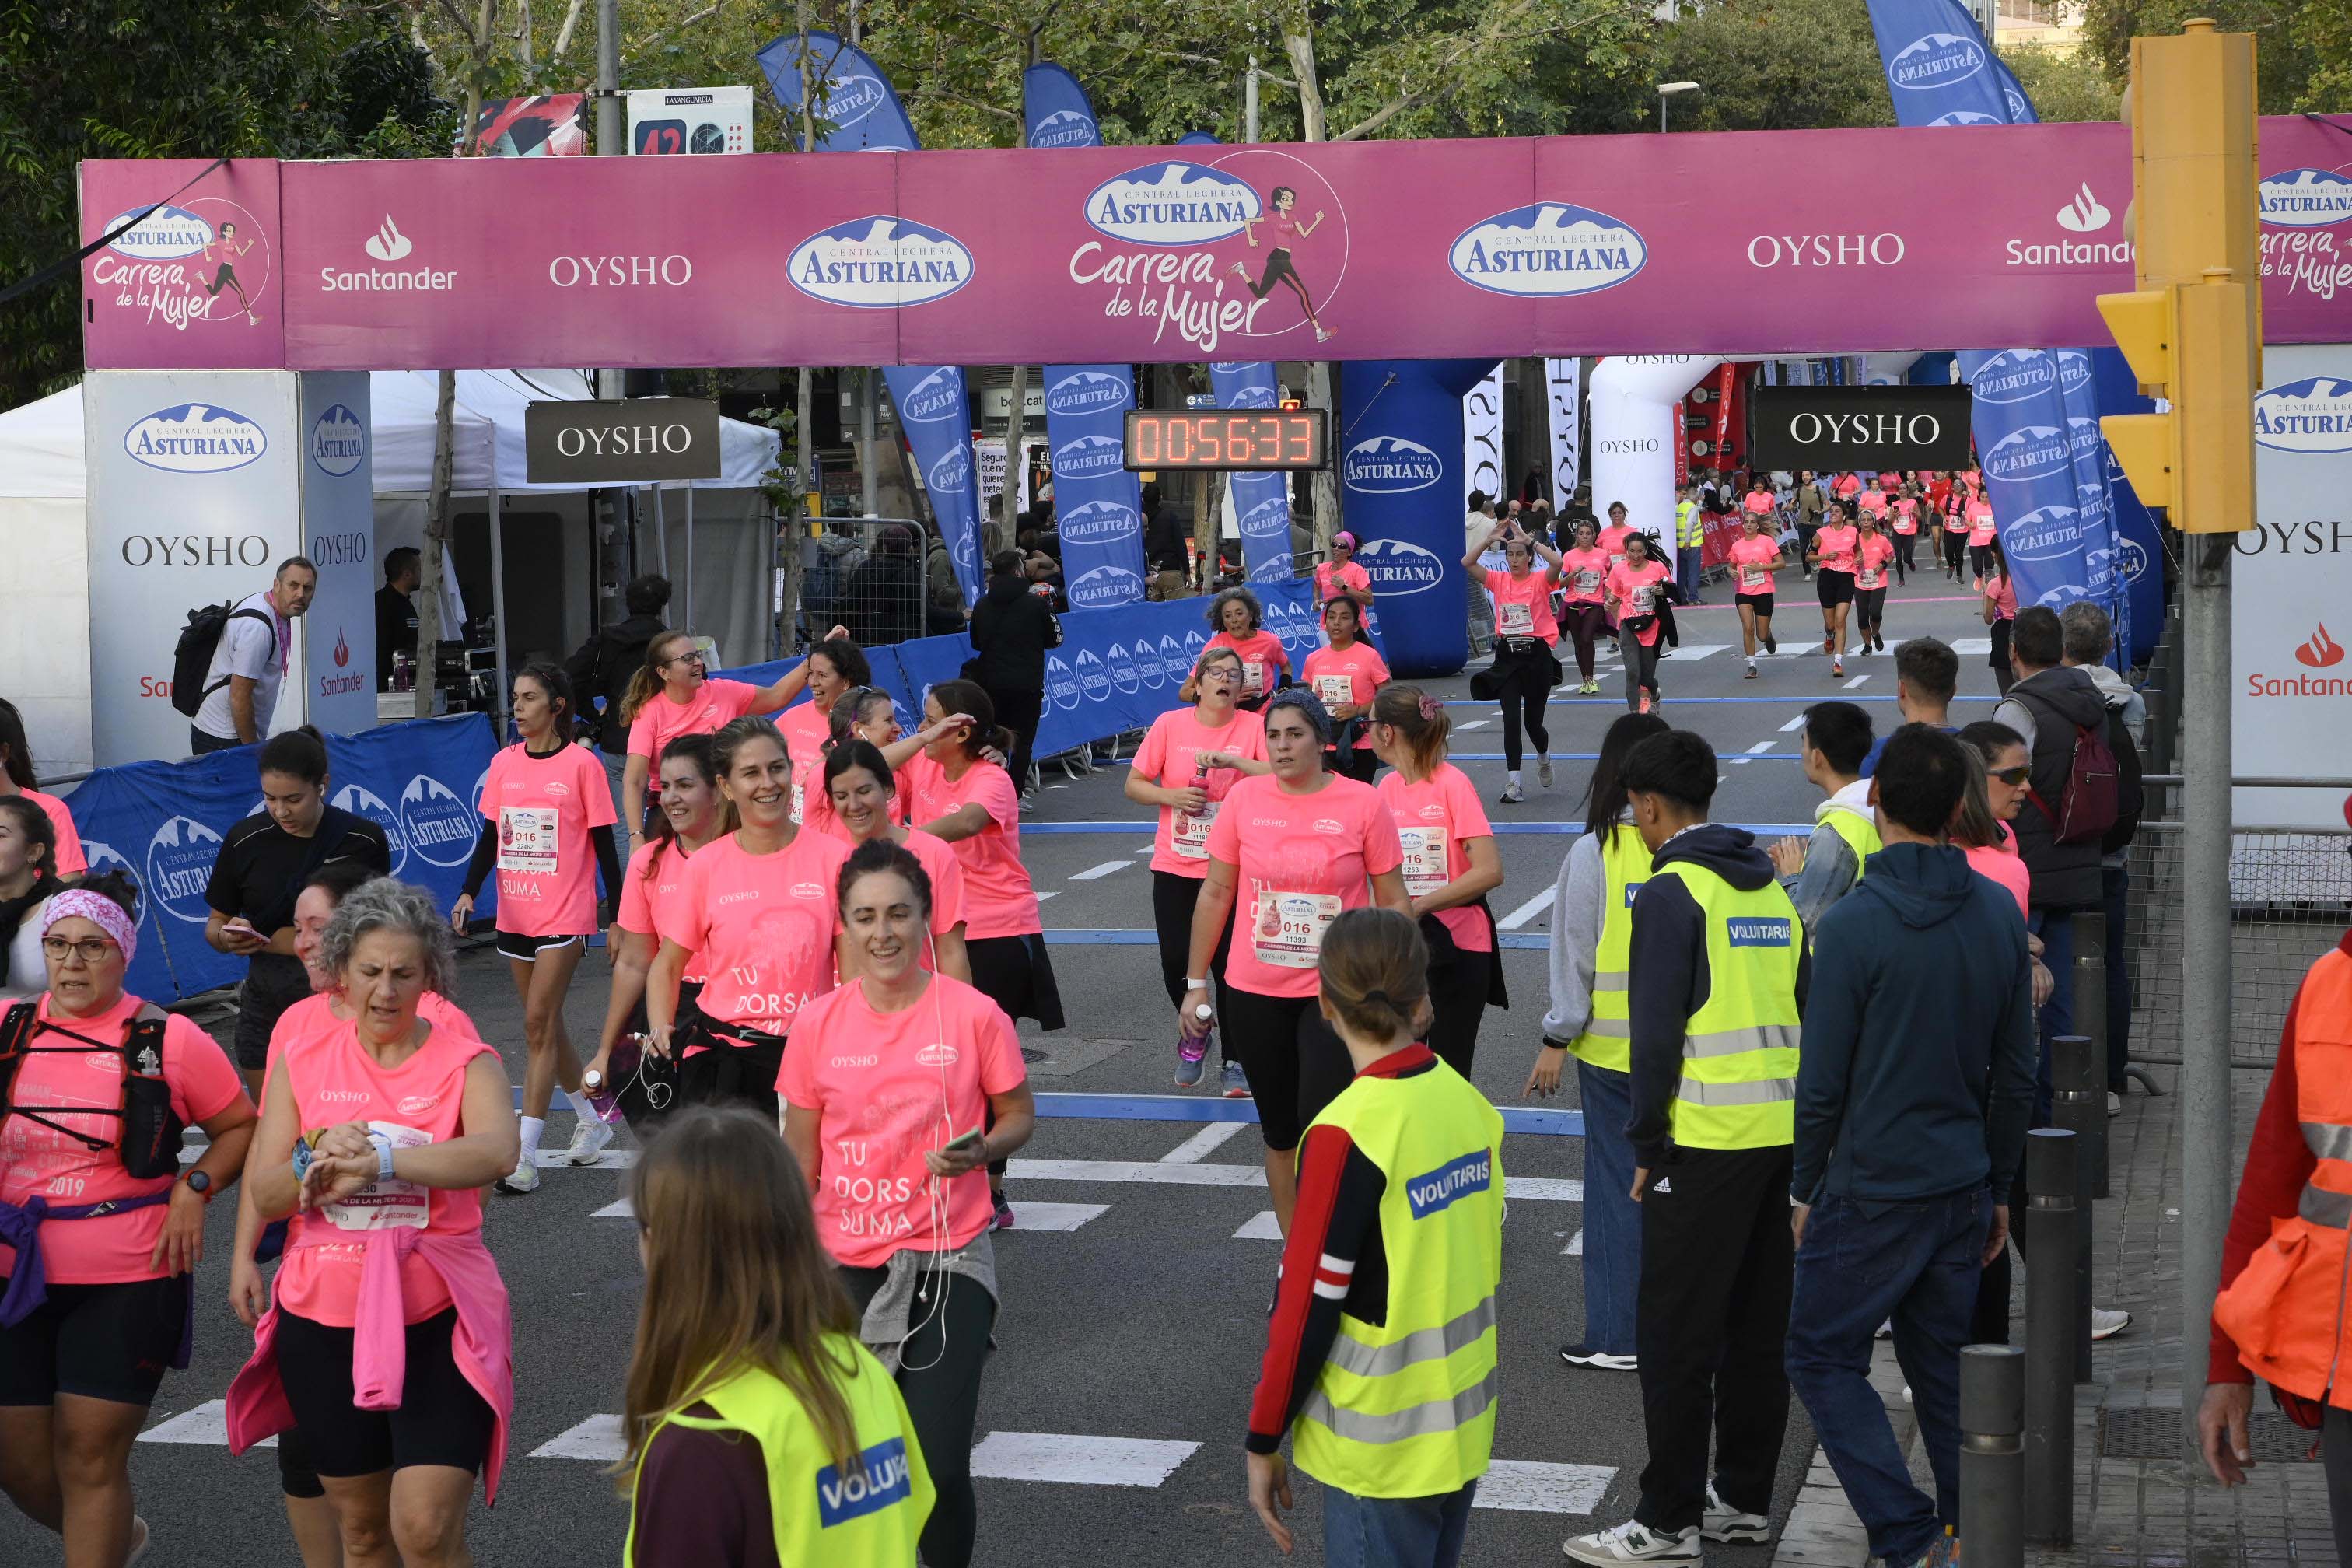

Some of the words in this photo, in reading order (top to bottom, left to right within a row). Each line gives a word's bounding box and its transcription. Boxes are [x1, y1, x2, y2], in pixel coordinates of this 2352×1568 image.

[1125, 191, 1181, 199] CENTRAL
[1186, 190, 1243, 198] LECHERA
[1098, 193, 1245, 224] ASTURIANA
[830, 247, 888, 257] CENTRAL
[894, 246, 953, 256] LECHERA
[1494, 235, 1556, 247] CENTRAL
[1562, 233, 1625, 244] LECHERA
[1748, 233, 1905, 267] OYSHO
[2259, 232, 2333, 254] arrera
[801, 250, 960, 285] ASTURIANA
[1069, 241, 1215, 285] Carrera
[1464, 239, 1632, 274] ASTURIANA
[93, 256, 184, 286] Carrera
[321, 266, 457, 292] Santander
[549, 255, 693, 287] OYSHO
[2278, 254, 2291, 275] la
[2288, 250, 2352, 300] Muje
[116, 286, 134, 306] de
[136, 285, 149, 306] la
[147, 282, 220, 331] Mujer
[1105, 287, 1132, 317] de
[1139, 286, 1157, 317] la
[1153, 278, 1270, 352] Mujer
[557, 425, 691, 456] OYSHO
[1138, 418, 1310, 461] 00:56:33
[1790, 414, 1940, 444] OYSHO
[135, 429, 257, 455] ASTURIANA
[317, 431, 361, 457] ASTURIANA
[1600, 439, 1659, 454] OYSHO
[1348, 460, 1435, 481] ASTURIANA
[122, 535, 269, 566] OYSHO
[314, 532, 366, 567] OYSHO
[1365, 566, 1436, 582] TURIANA
[321, 672, 364, 697] Santander
[408, 812, 473, 847] ASTURIANA
[1190, 824, 1211, 833] 016
[1252, 818, 1286, 828] OYSHO
[516, 832, 536, 842] 016
[502, 880, 541, 896] SUMA
[719, 891, 759, 905] OYSHO
[1283, 905, 1314, 914] ASTURIANA
[1284, 922, 1311, 934] 016
[731, 965, 758, 986] TU
[734, 992, 817, 1016] DORSA
[831, 1054, 878, 1068] OYSHO
[320, 1090, 370, 1103] OYSHO
[838, 1141, 866, 1166] TU
[46, 1177, 86, 1197] 2019
[840, 1208, 914, 1236] SUMA
